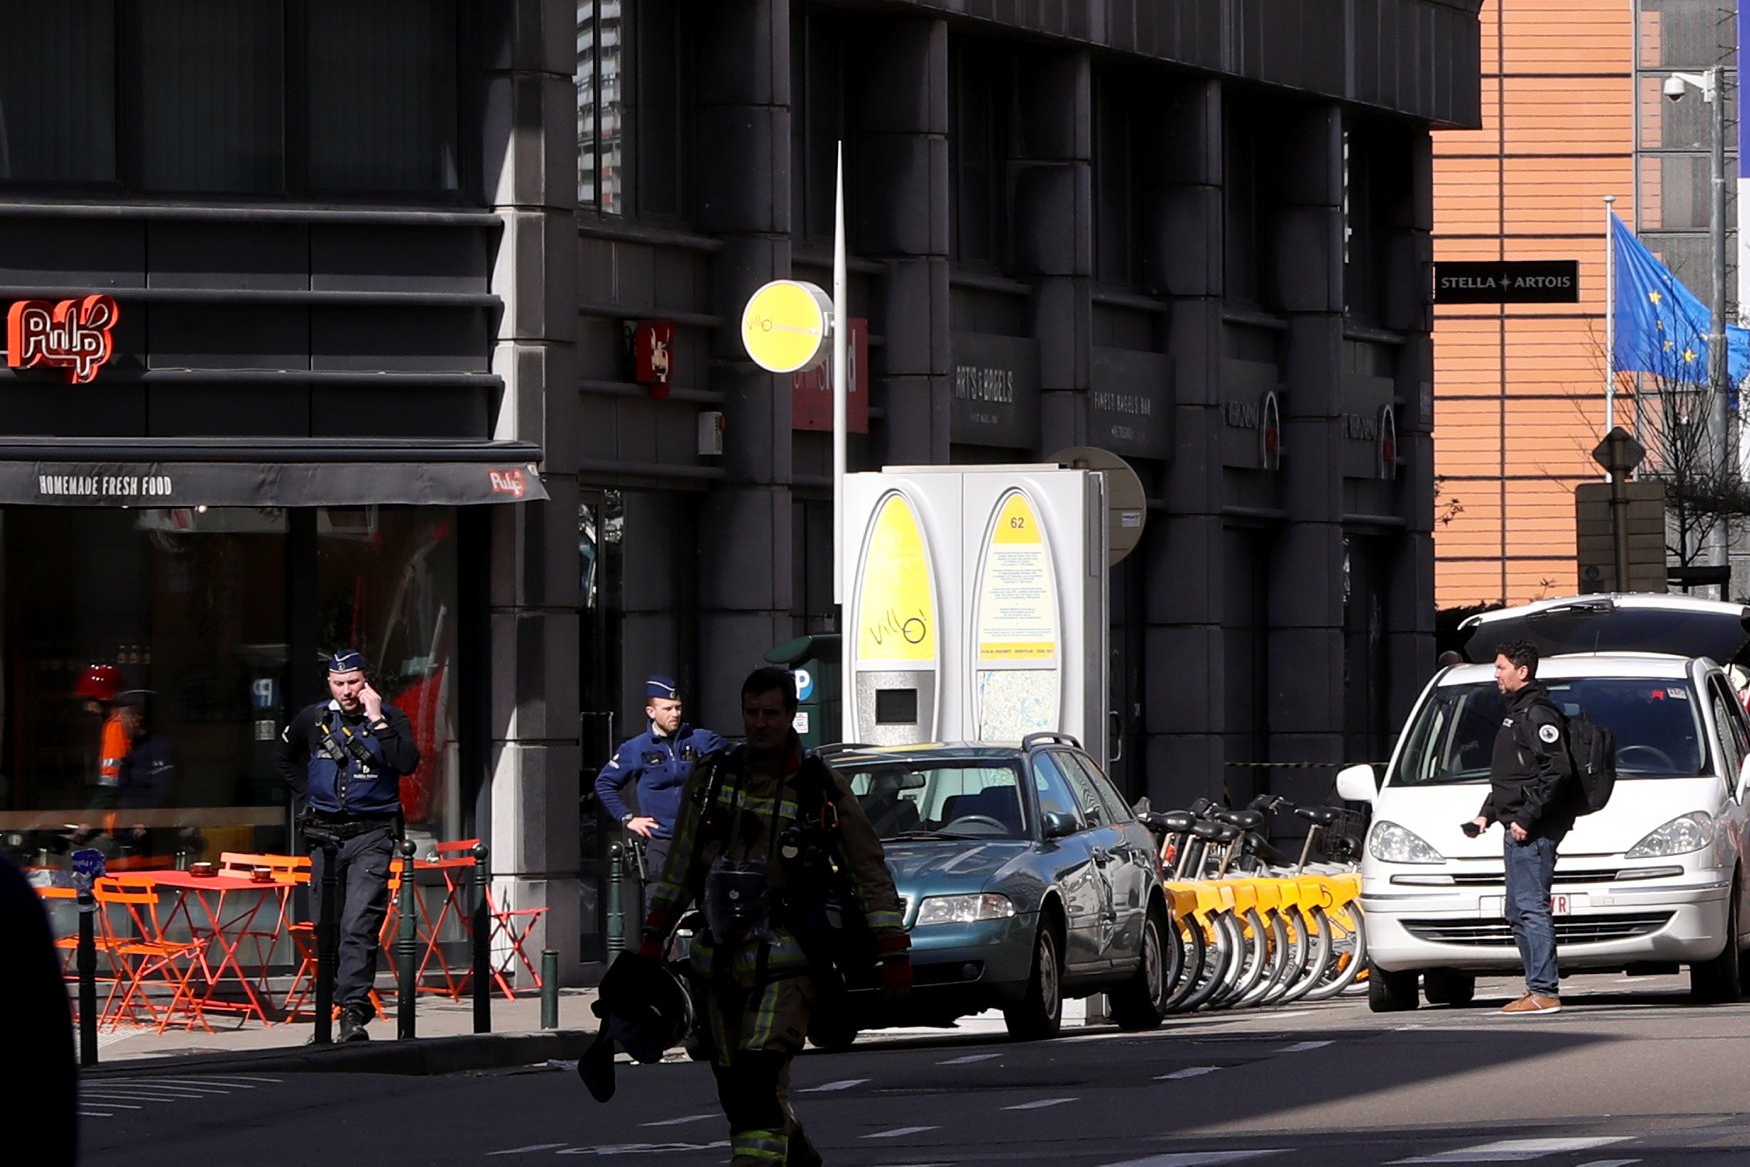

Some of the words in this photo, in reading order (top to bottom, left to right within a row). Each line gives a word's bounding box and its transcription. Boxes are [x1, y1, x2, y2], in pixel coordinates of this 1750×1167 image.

[1441, 276, 1497, 289] STELLA
[1514, 275, 1571, 288] ARTOIS
[14, 298, 113, 379] Pulp
[39, 475, 99, 495] HOMEMADE
[102, 476, 138, 496] FRESH
[142, 476, 172, 496] FOOD
[1010, 516, 1025, 530] 62
